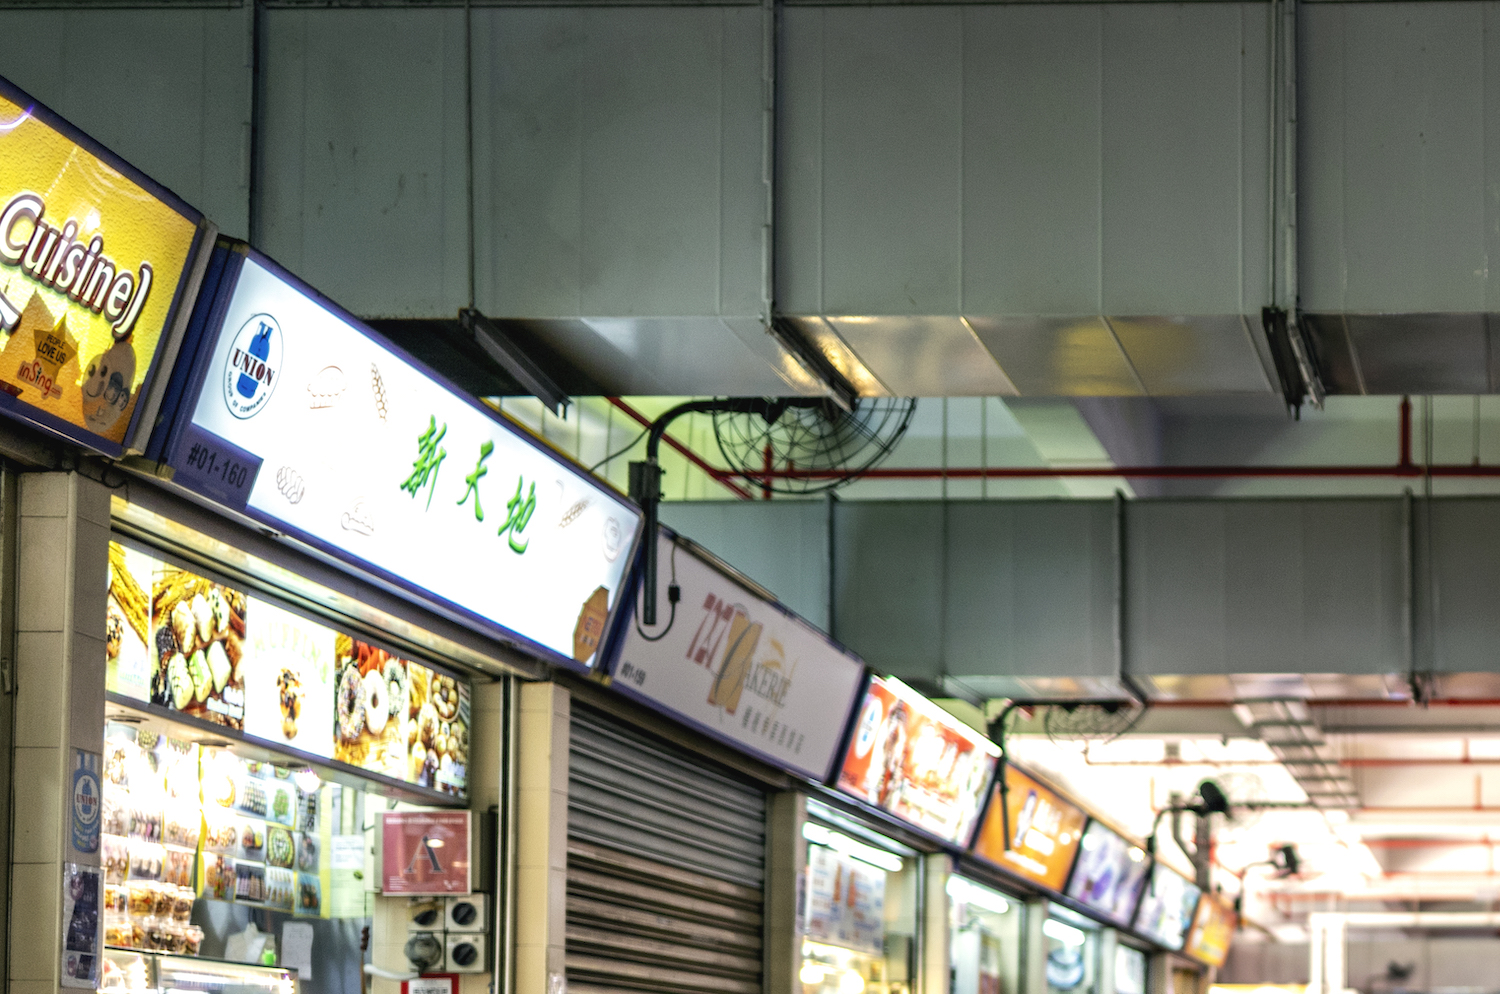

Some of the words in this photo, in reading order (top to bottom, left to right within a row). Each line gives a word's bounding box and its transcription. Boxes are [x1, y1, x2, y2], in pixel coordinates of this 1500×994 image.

[0, 194, 153, 340] Cuisine)
[37, 341, 57, 359] LOVE
[56, 350, 67, 364] US
[45, 333, 66, 350] PEOPLE
[233, 347, 275, 387] UNION
[186, 442, 248, 490] #01-160
[76, 793, 97, 806] UNION
[403, 834, 446, 875] A
